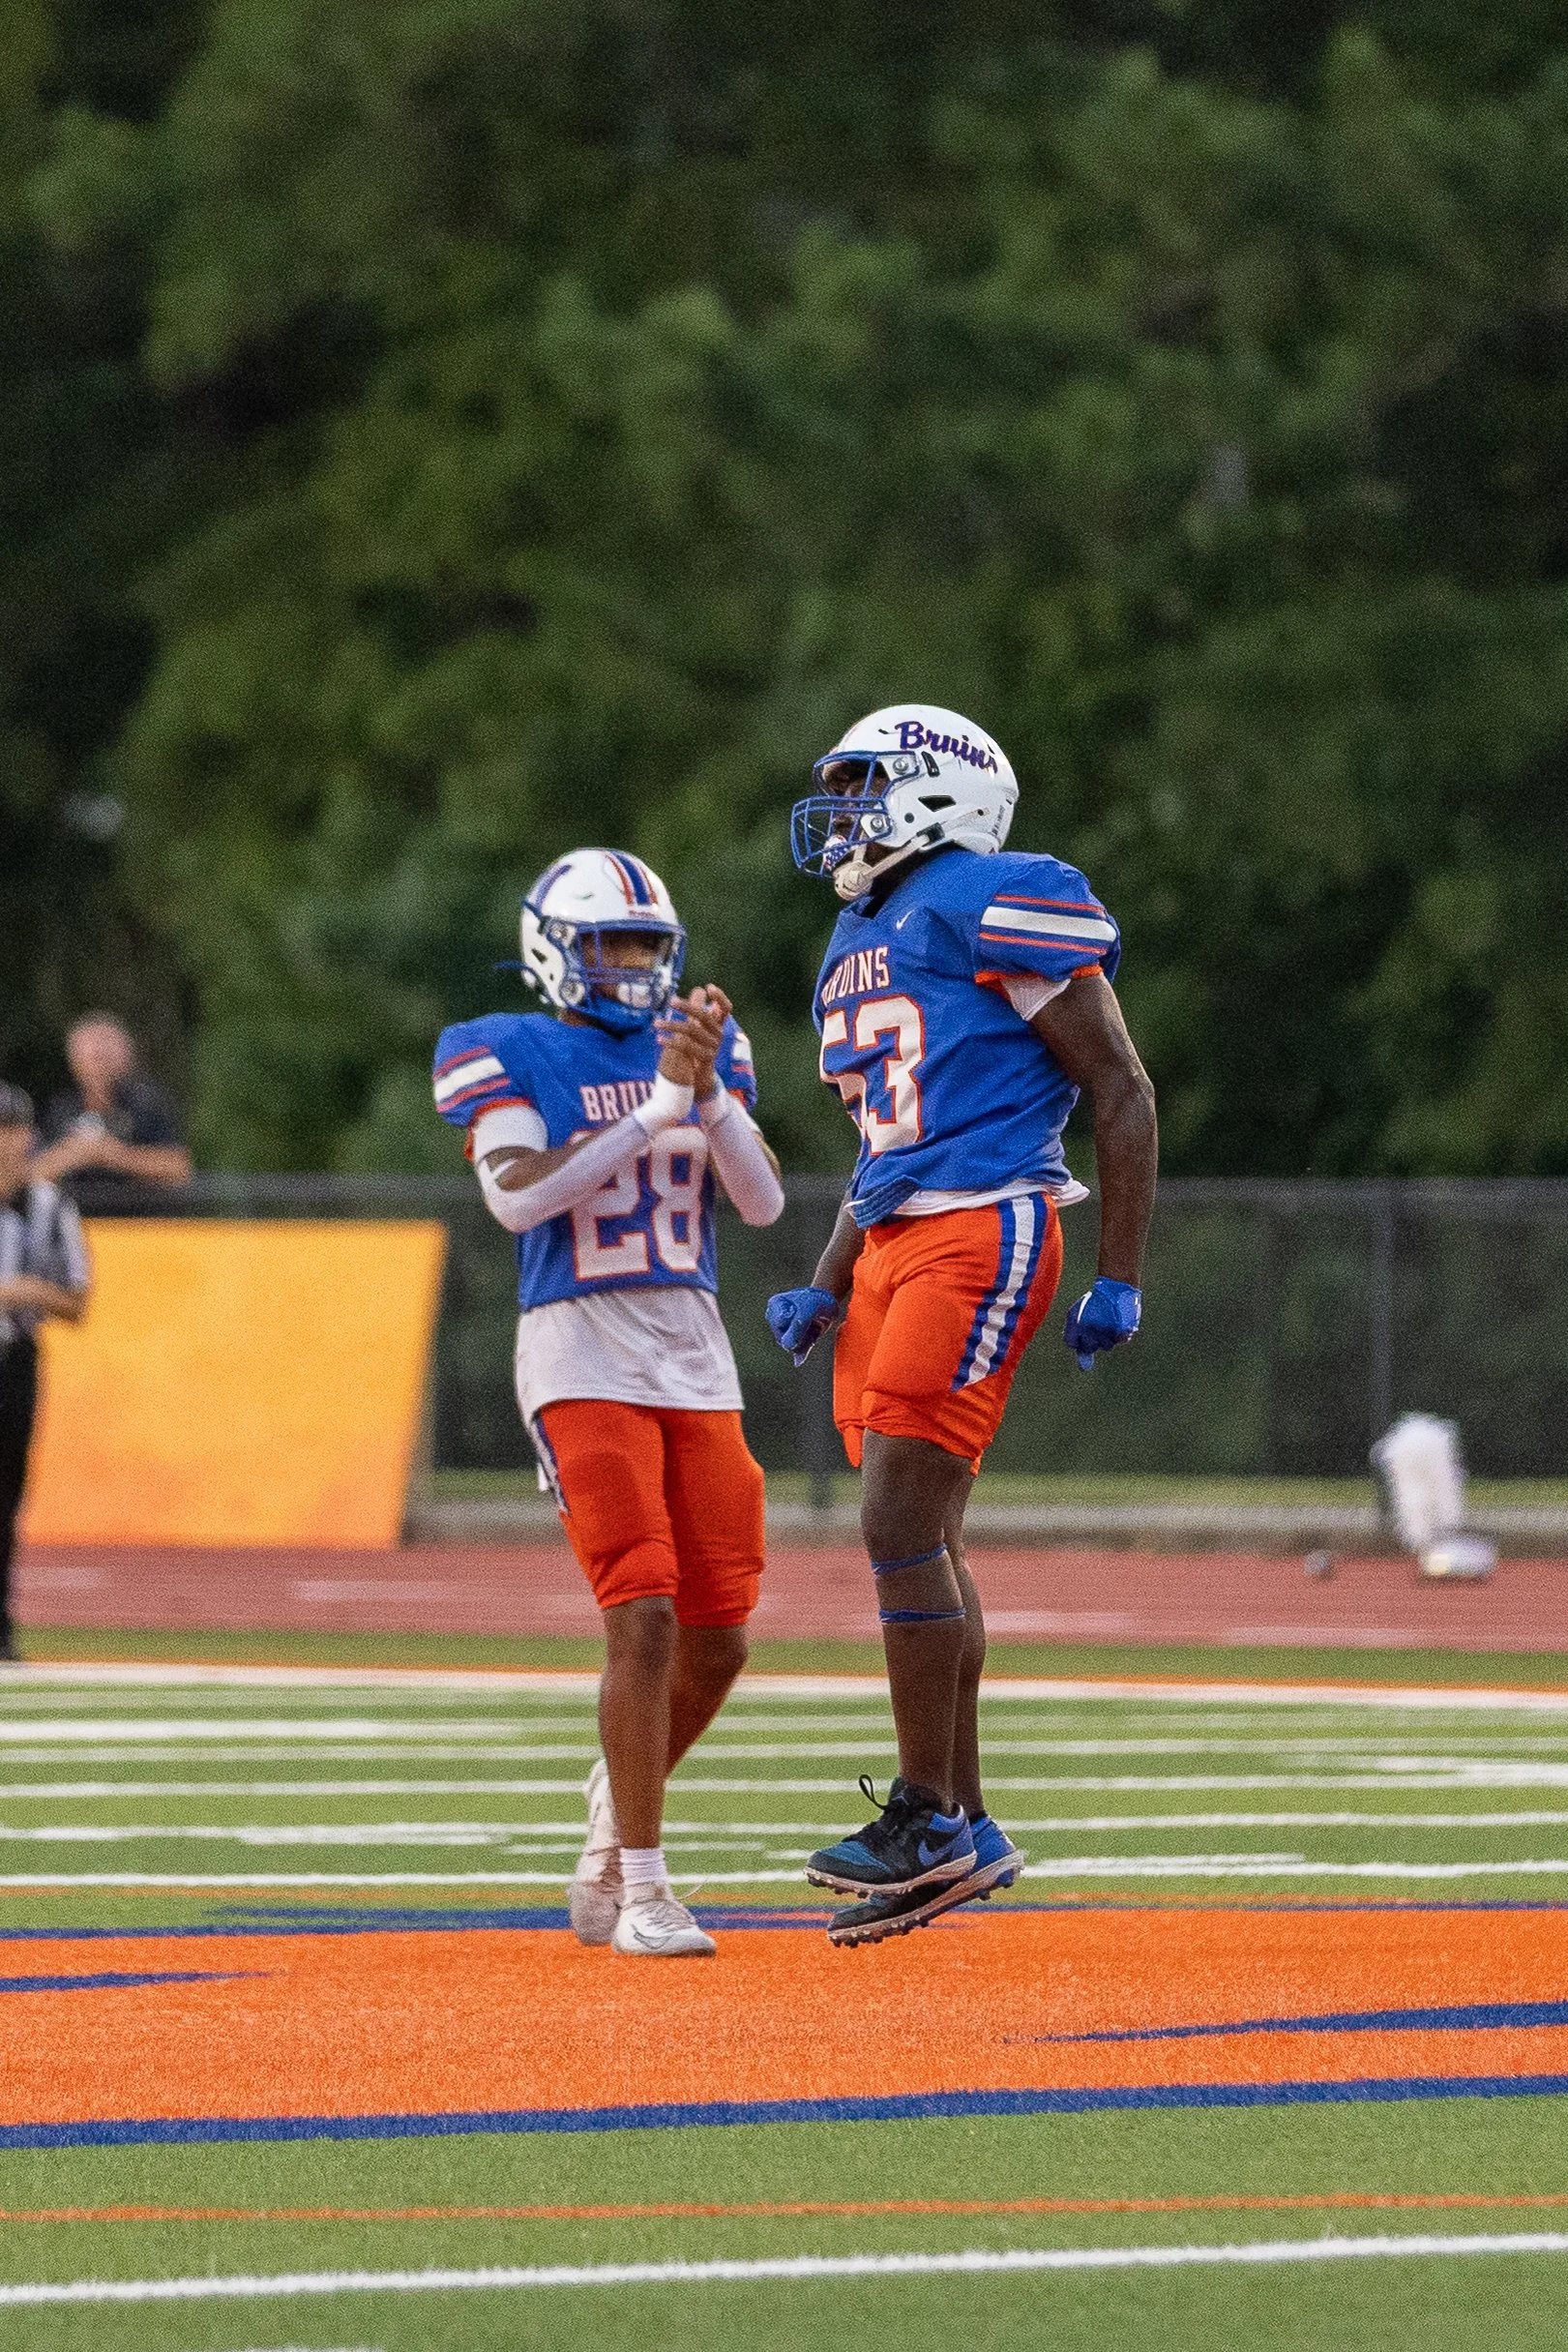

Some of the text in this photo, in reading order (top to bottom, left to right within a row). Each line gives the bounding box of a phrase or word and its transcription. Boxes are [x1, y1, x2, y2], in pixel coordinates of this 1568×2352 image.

[895, 721, 998, 775] Bruins
[579, 1081, 655, 1121] BRUI
[819, 993, 926, 1156] 53
[567, 1123, 709, 1282] 28
